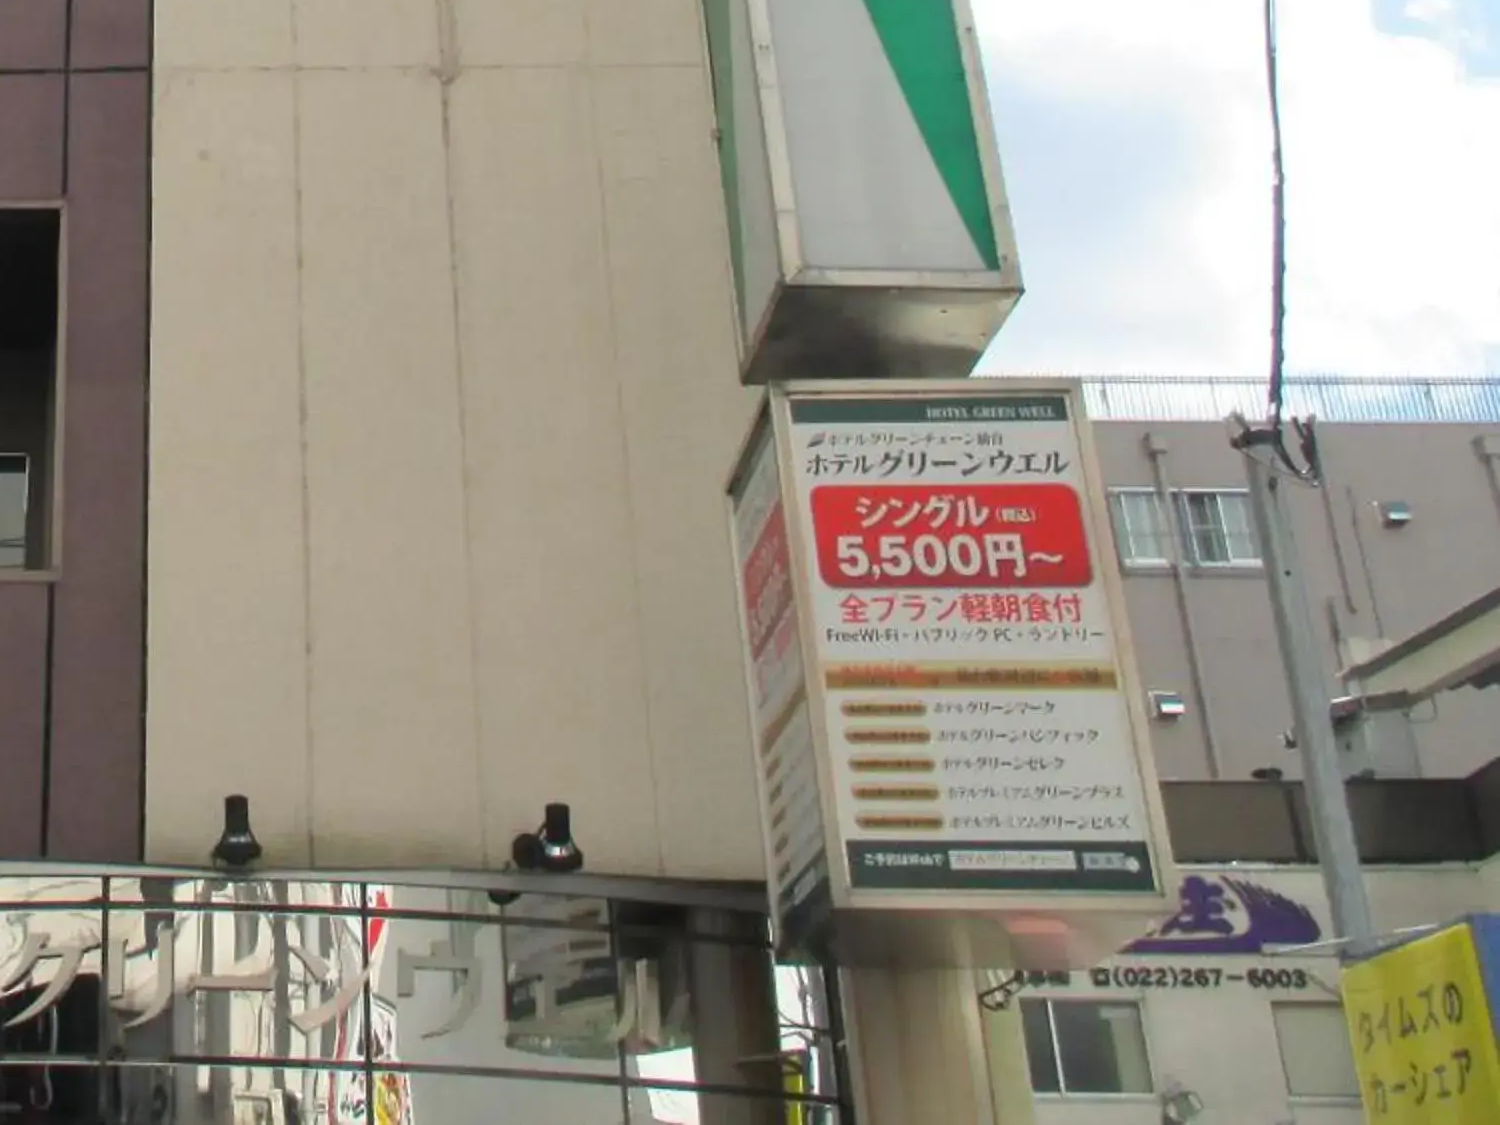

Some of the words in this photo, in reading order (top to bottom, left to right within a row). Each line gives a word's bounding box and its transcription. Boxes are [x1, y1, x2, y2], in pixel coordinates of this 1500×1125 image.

[925, 405, 968, 419] HOTEL
[973, 404, 1016, 419] GREEN
[1018, 403, 1055, 418] WELL
[806, 450, 1071, 477] ホテルグリーンウエル
[855, 494, 989, 529] シングル
